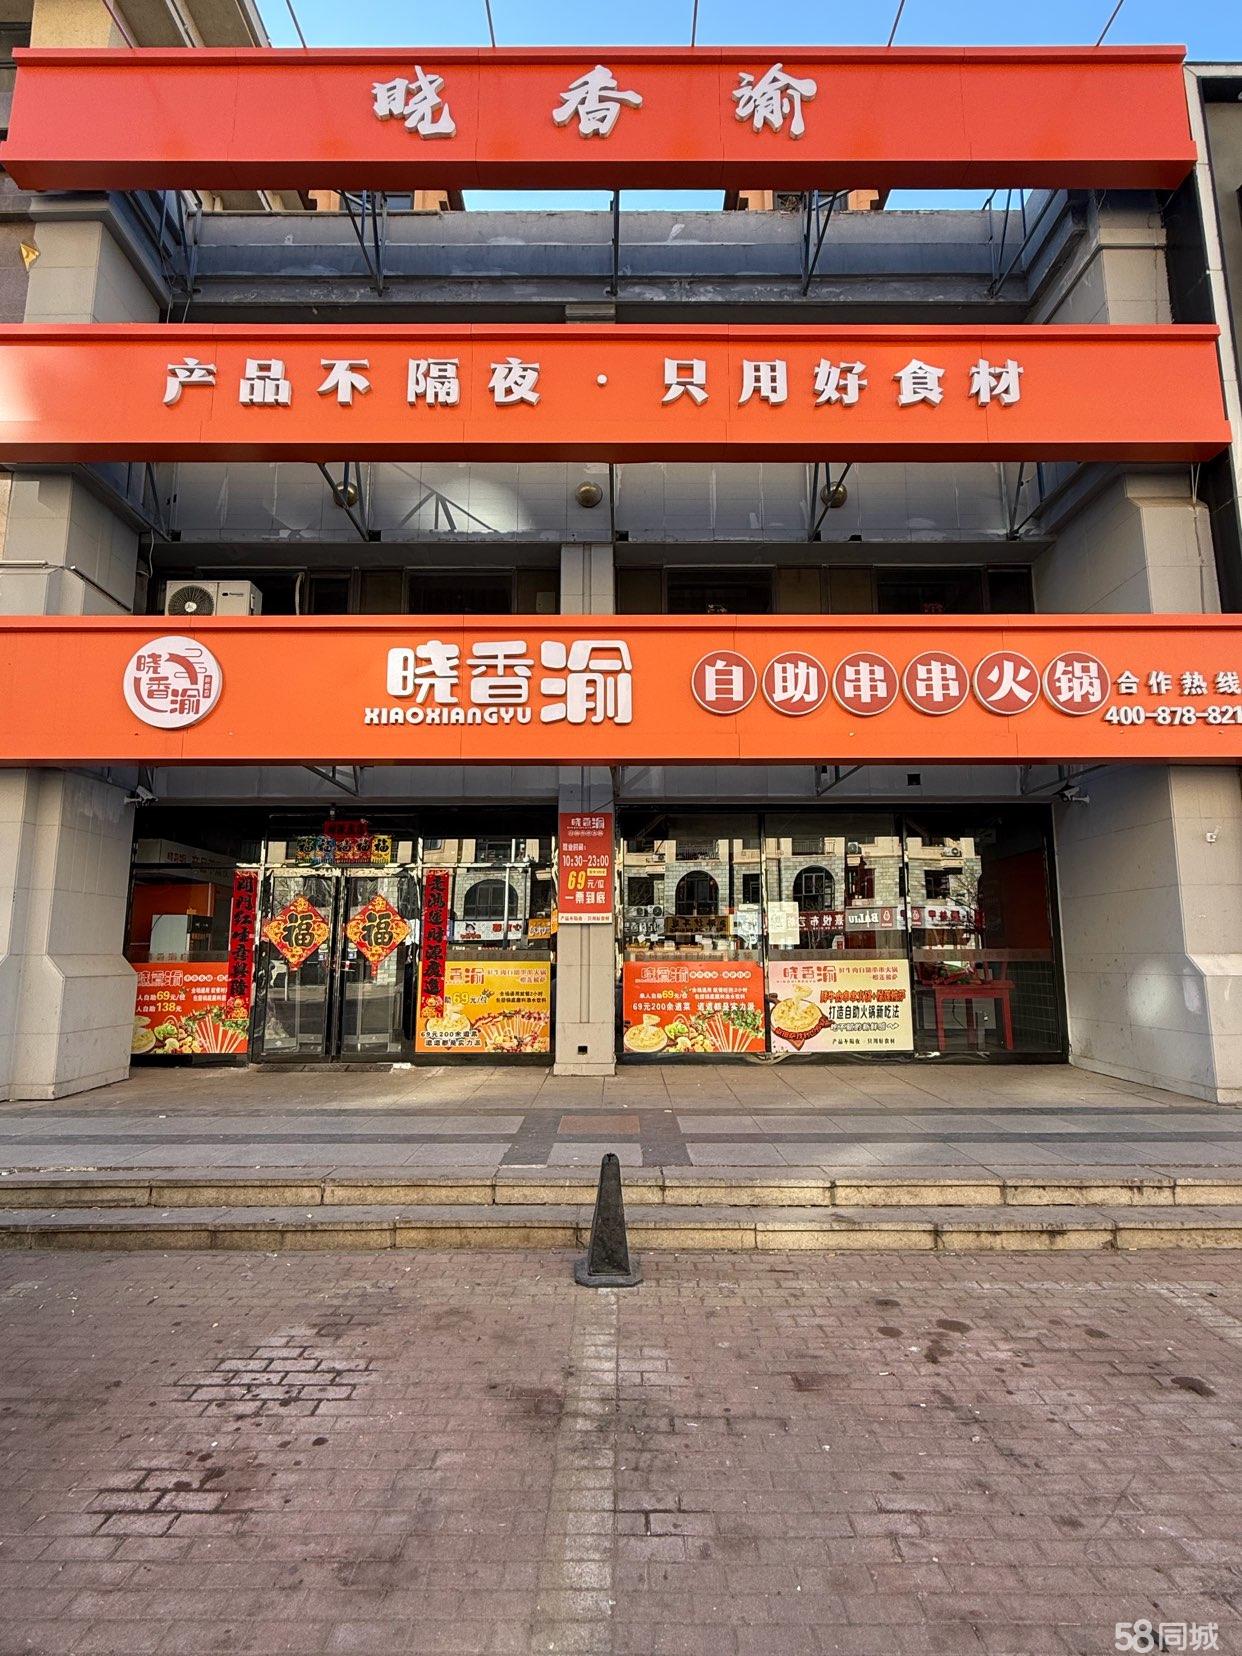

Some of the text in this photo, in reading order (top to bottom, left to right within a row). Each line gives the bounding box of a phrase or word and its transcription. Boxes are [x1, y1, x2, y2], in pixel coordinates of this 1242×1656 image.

[372, 64, 818, 140] 晓香渝
[387, 639, 633, 725] 晓香渝
[703, 658, 1103, 704] 自助串串火锅
[1115, 670, 1242, 696] 合作热线
[364, 706, 533, 726] XIAOXIANGYU
[562, 855, 610, 867] 10:30-23:00
[567, 870, 605, 890] 69 元/位
[282, 912, 315, 947] 福
[361, 912, 393, 947] 福
[783, 966, 837, 982] 晓香渝
[828, 1004, 900, 1019] 打造自助火锅新吃法
